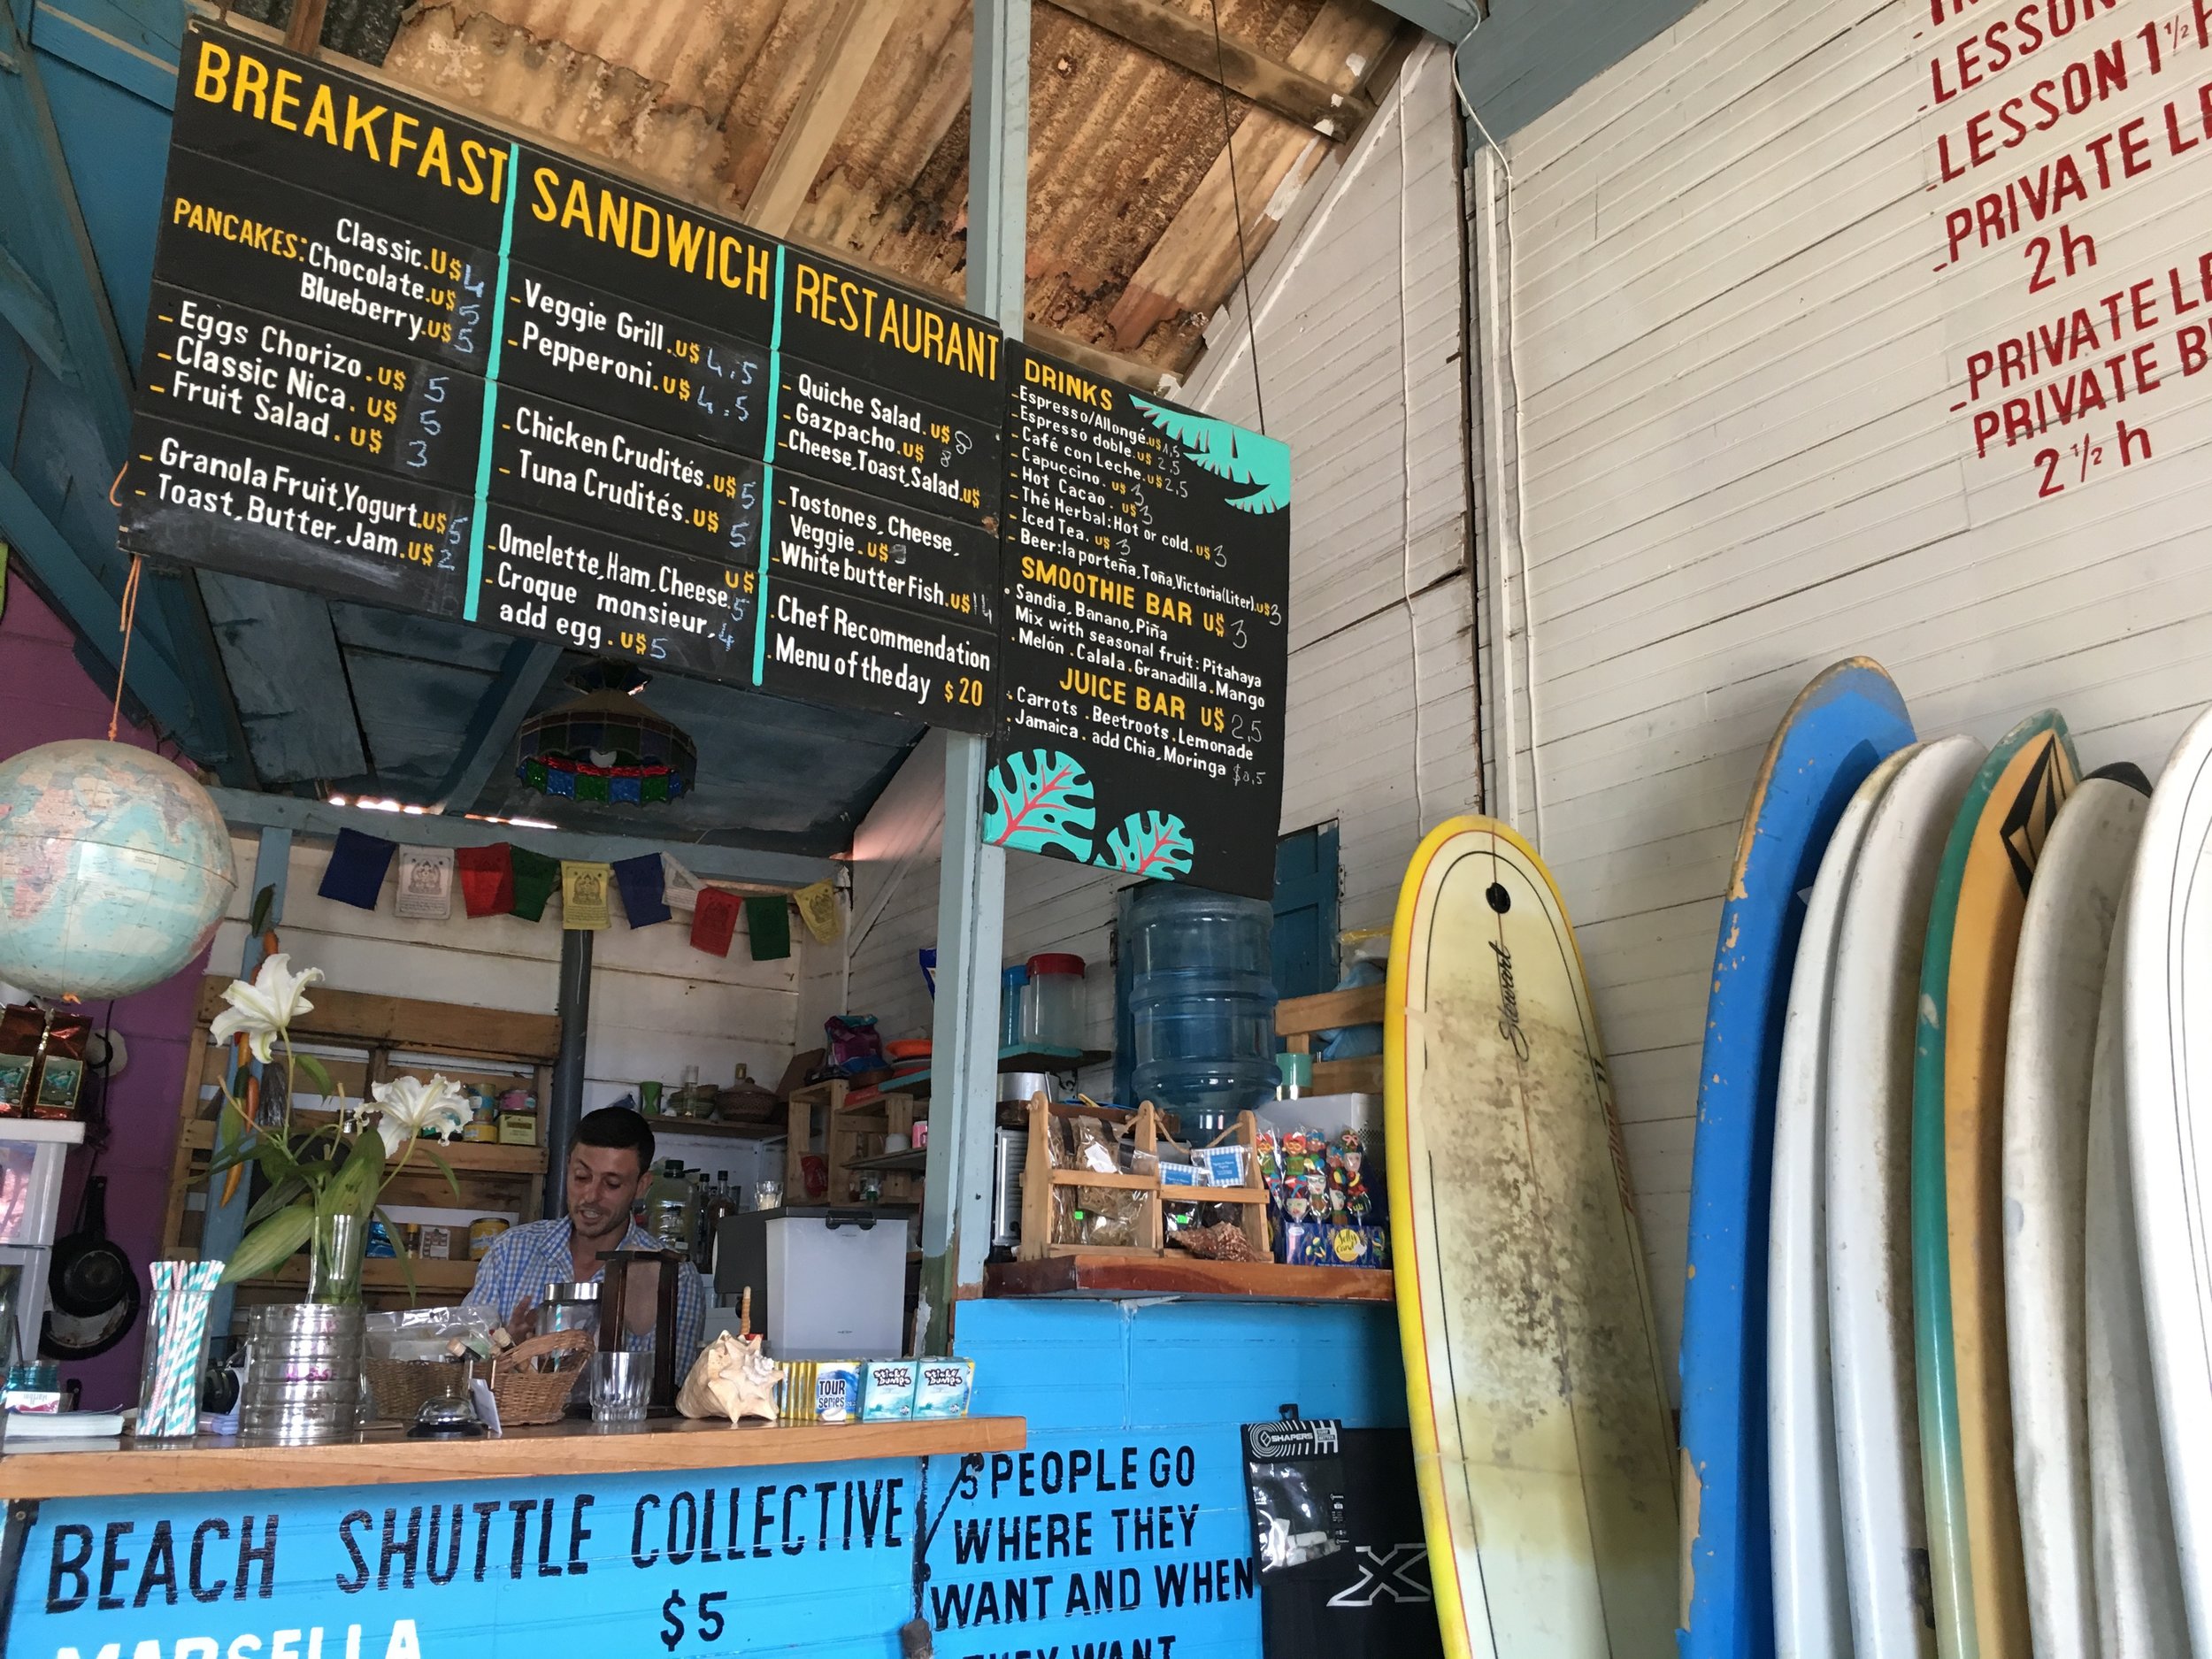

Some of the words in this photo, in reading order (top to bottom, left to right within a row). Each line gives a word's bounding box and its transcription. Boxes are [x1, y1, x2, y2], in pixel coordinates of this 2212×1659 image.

[194, 41, 508, 204] BREAKFAST
[1938, 39, 2129, 183] LESSON
[1945, 117, 2153, 264] PRIVATE
[173, 197, 307, 263] PANCAKES:
[532, 167, 769, 301] SANDWICH
[464, 264, 485, 298] 4
[525, 279, 607, 333] Veggie
[180, 300, 249, 345] Eggs
[424, 377, 449, 403] 5
[795, 264, 999, 381] RESTAURANT
[1966, 277, 2159, 402] PRIVATE
[176, 336, 279, 389] Classic
[419, 410, 442, 436] 5
[799, 373, 864, 415] Quiche
[1024, 357, 1113, 411] DRINKS
[1973, 342, 2162, 459] PRIVATE
[172, 371, 243, 416] Fruit
[406, 440, 428, 468] 3
[1020, 405, 1087, 442] Espresso
[1022, 426, 1058, 452] Café
[1064, 445, 1093, 463] con
[160, 437, 267, 489] Granola
[516, 406, 608, 460] Chicken
[741, 481, 757, 510] 5
[1022, 465, 1050, 490] Hot
[519, 449, 577, 493] Tuna
[729, 521, 750, 549] 5
[1022, 486, 1050, 510] Thé
[1113, 516, 1140, 537] Hot
[1143, 528, 1157, 542] or
[1213, 544, 1228, 569] 3
[1021, 506, 1054, 531] Iced
[1116, 538, 1132, 557] 3
[497, 561, 577, 603] Croque
[781, 540, 840, 578] White
[843, 557, 905, 599] butter
[500, 602, 547, 631] add
[649, 637, 668, 660] 5
[1021, 556, 1135, 610] SMOOTHIE
[1145, 592, 1193, 626] BAR
[1230, 619, 1248, 649] 3
[1135, 618, 1168, 641] Piña
[776, 633, 830, 672] Menu
[778, 594, 830, 632] Chef
[833, 607, 990, 672] Recommendation
[1015, 604, 1043, 627] Mix
[1048, 618, 1084, 639] with
[1089, 630, 1154, 658] seasonal
[1202, 657, 1263, 688] Pitahaya
[1018, 627, 1064, 655] Melón
[1017, 686, 1079, 717] Carrots
[1059, 667, 1126, 706] JUICE
[1136, 687, 1186, 721] BAR
[1092, 728, 1120, 749] add
[1164, 744, 1227, 779] Moringa
[818, 1379, 846, 1396] TOUR
[818, 1395, 845, 1409] series
[1271, 1432, 1314, 1442] SHAPERS
[991, 1447, 1137, 1499] PEOPLE
[1149, 1445, 1195, 1488] GO
[45, 1514, 280, 1615] BEACH
[336, 1494, 595, 1594] SHUTTLE
[631, 1478, 904, 1569] COLLECTIVE
[954, 1510, 1093, 1564] WHERE
[1110, 1503, 1199, 1553] THEY
[660, 1589, 727, 1652] $5
[930, 1575, 1054, 1632] WANT
[1064, 1567, 1141, 1618] AND
[1154, 1556, 1255, 1609] WHEN
